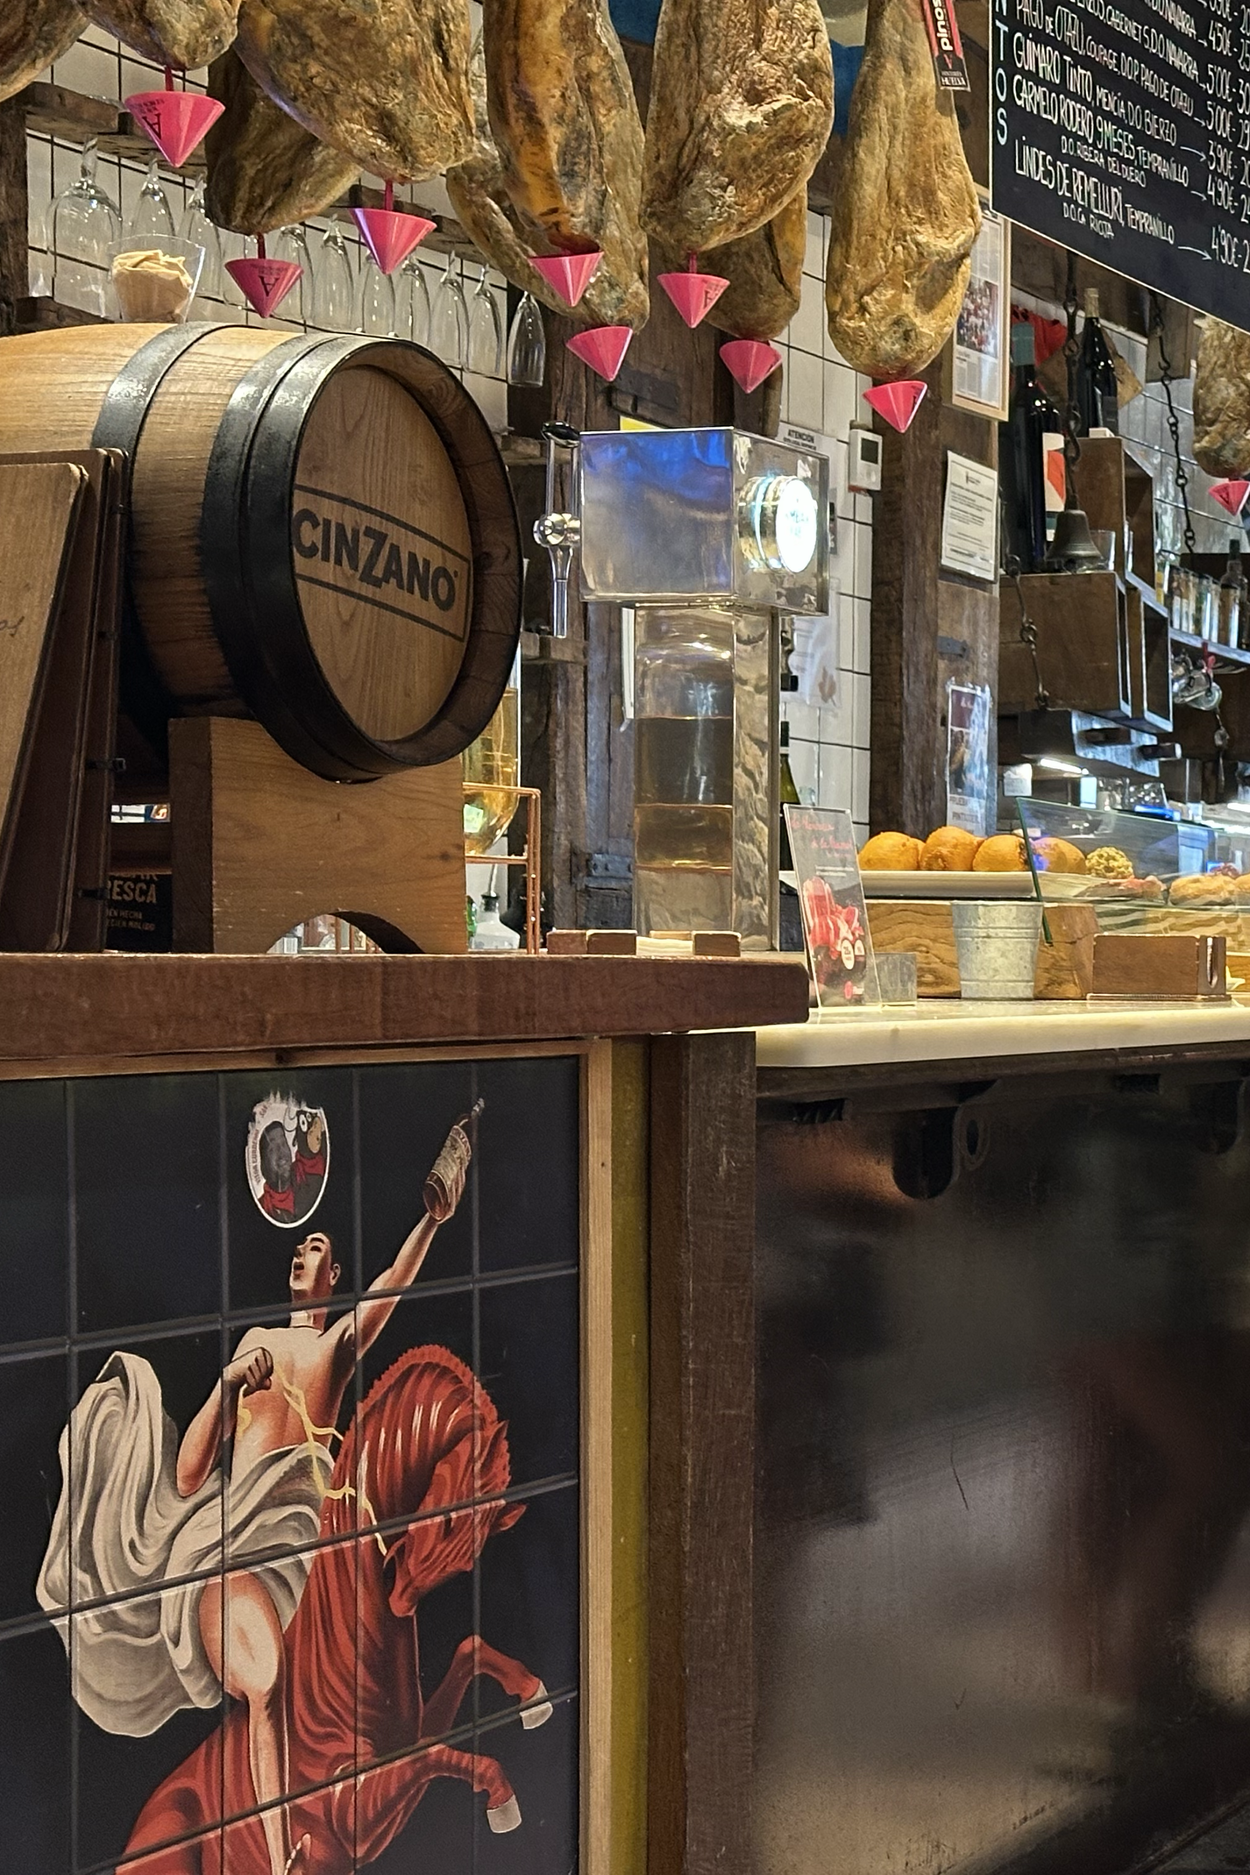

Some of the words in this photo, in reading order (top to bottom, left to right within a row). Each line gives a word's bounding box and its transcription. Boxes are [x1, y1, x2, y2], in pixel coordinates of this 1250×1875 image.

[1012, 74, 1058, 125] CARMELO
[1059, 94, 1094, 144] RODERO
[291, 508, 456, 612] CINZANO
